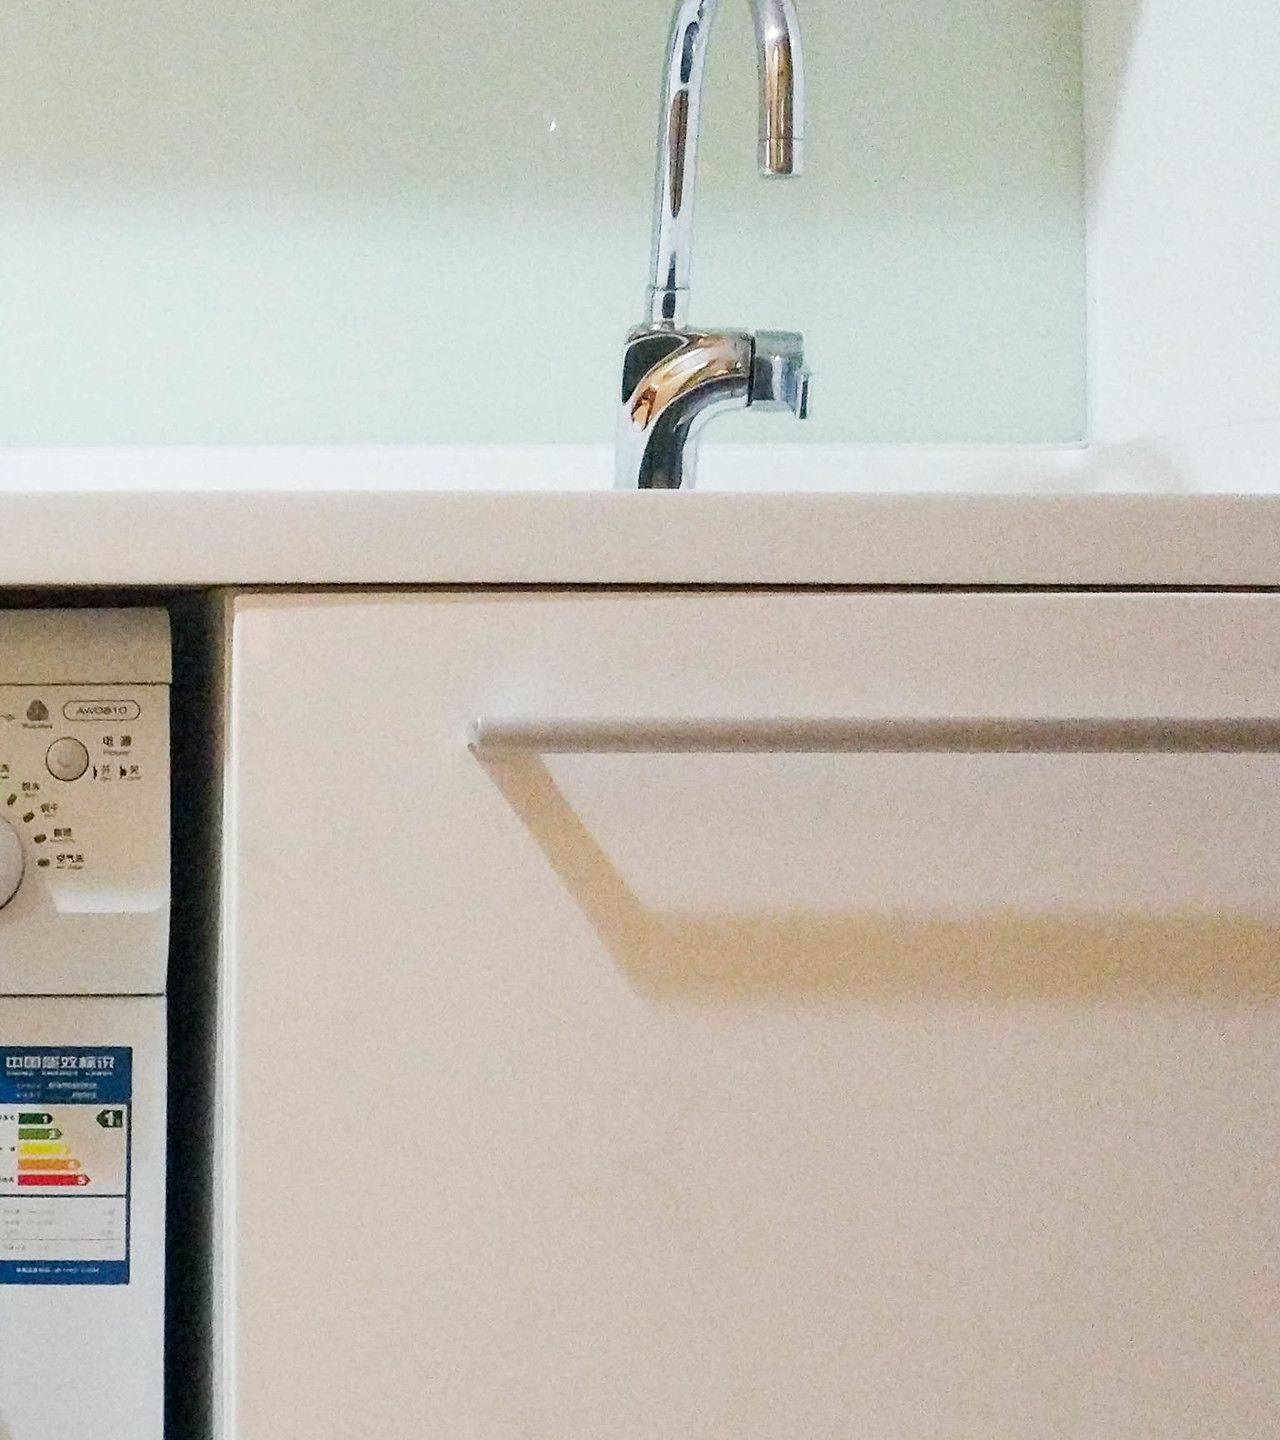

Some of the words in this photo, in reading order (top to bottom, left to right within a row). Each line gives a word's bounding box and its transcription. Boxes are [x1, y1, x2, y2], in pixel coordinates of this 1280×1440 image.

[5, 1055, 115, 1070] 中国能效标识
